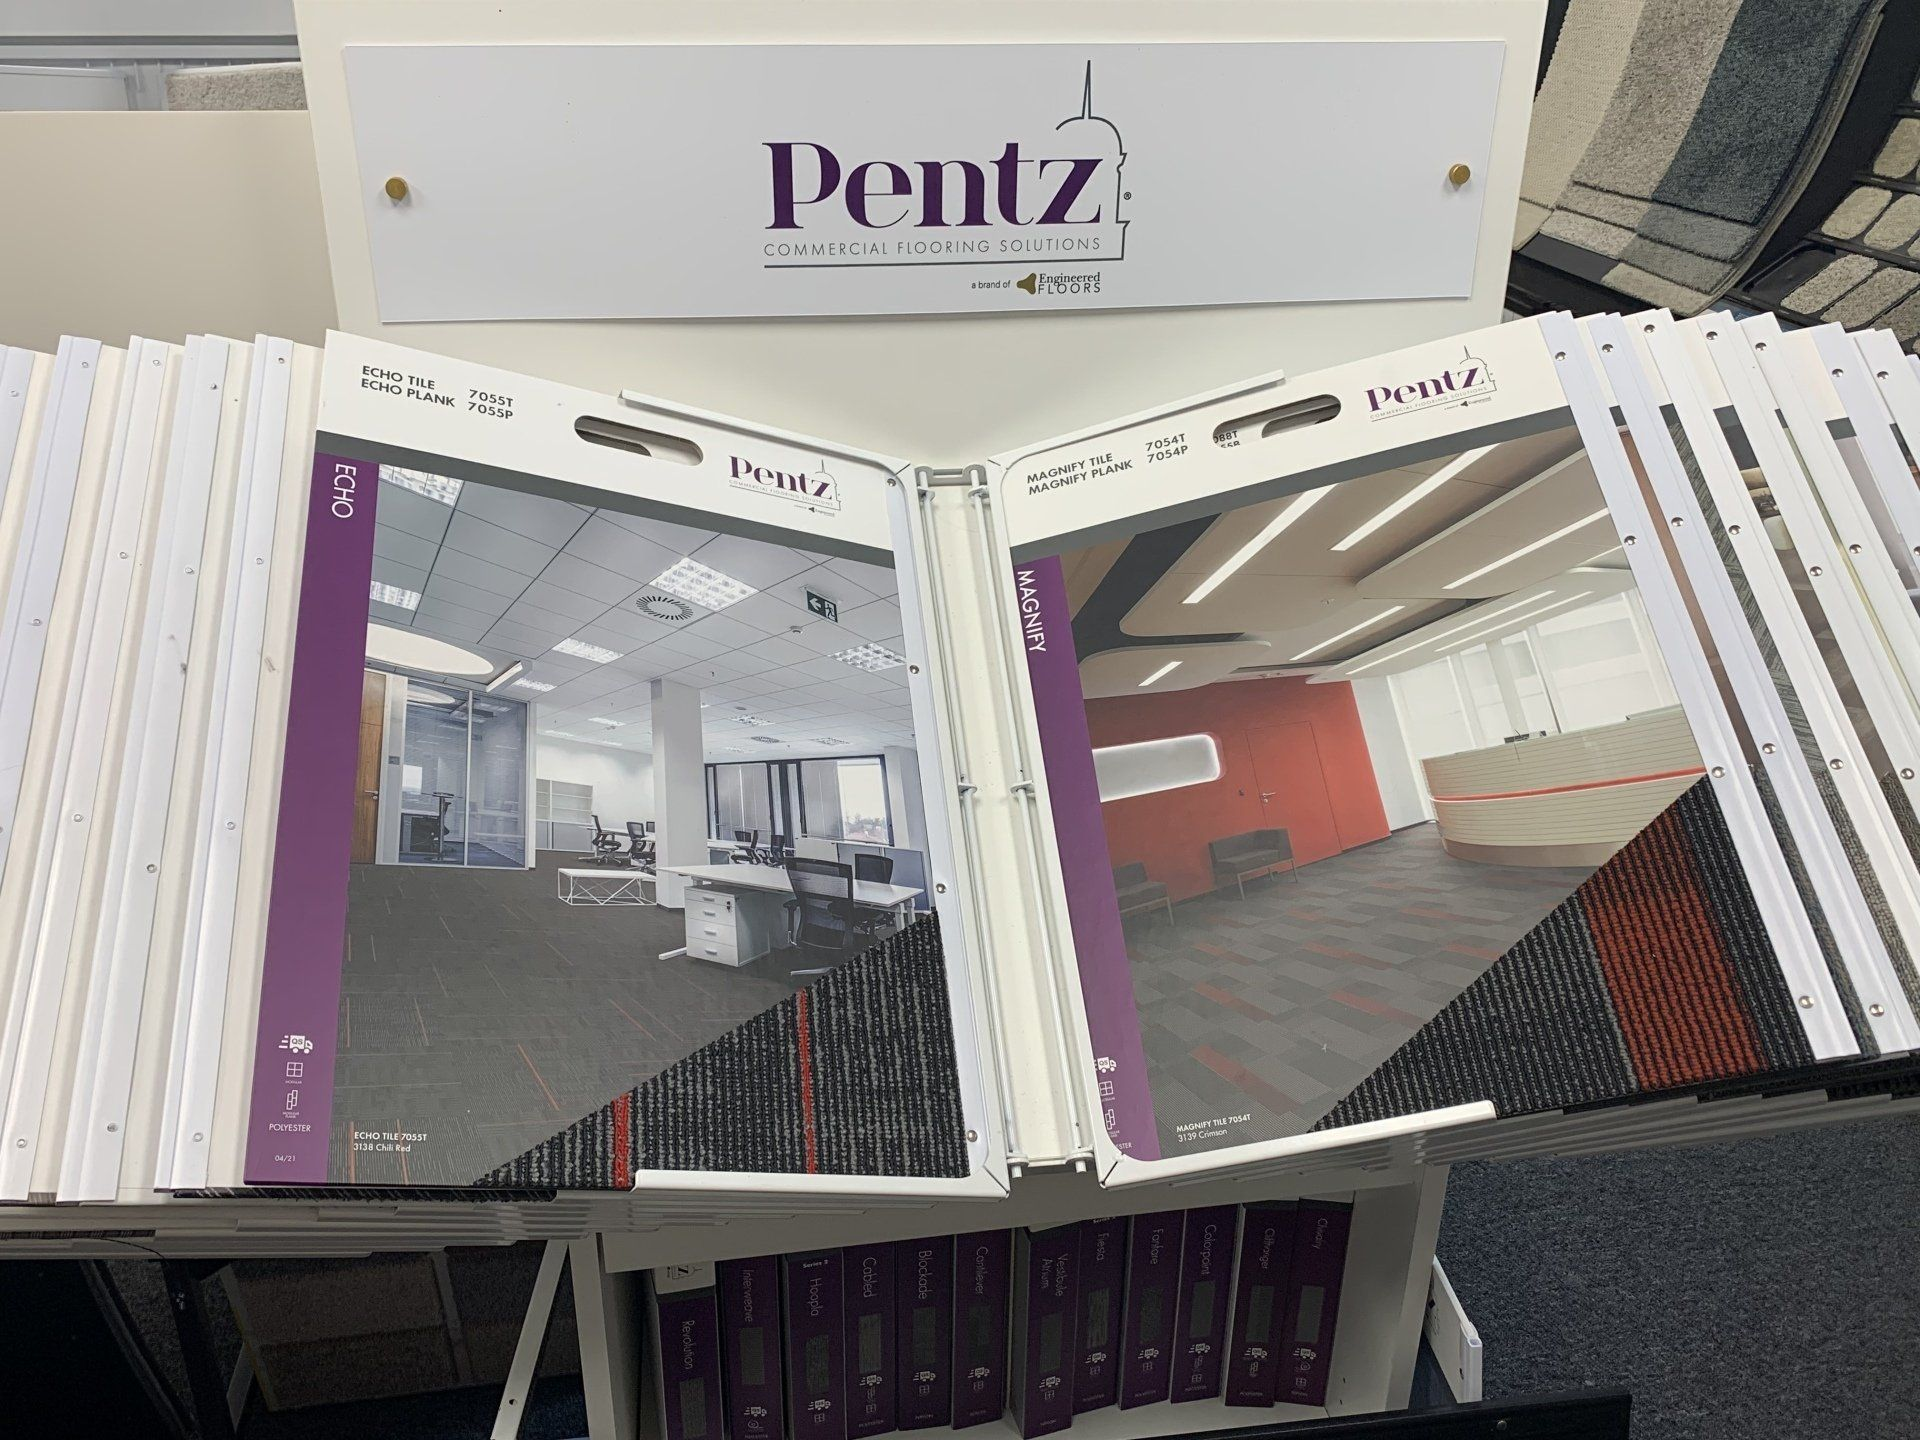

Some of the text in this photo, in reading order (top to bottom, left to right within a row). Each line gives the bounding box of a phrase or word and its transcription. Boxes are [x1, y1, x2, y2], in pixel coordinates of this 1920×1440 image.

[761, 142, 1104, 229] Pentz
[764, 237, 1100, 257] COMMERCIAL FLOORING SOLUTIONS
[978, 280, 1001, 289] brand
[1003, 280, 1011, 288] of
[1038, 282, 1101, 294] FLOORS
[1039, 271, 1101, 287] Engineered
[361, 378, 514, 420] ECHO PLANK 7055P
[362, 365, 514, 408] ECHO TILE 7055T
[1364, 367, 1485, 412] Pentz
[1145, 433, 1186, 452] 7054T
[1147, 444, 1189, 464] 7054P
[728, 455, 832, 499] Pentz
[1026, 452, 1113, 484] MAGNIFY TILE
[1028, 459, 1133, 495] MAGNIFY PLANK
[332, 463, 356, 519] ECHO
[1017, 569, 1046, 653] MAGNIFY
[268, 1122, 312, 1133] POLYESTER
[354, 1131, 428, 1142] ECHO TILE 7055T
[1176, 1113, 1251, 1133] MAGNIFY TILE 7054T
[1177, 1128, 1228, 1143] 3139 Crimson
[274, 1154, 296, 1162] 04/21
[353, 1142, 411, 1152] 3138 Chili Red
[1201, 1224, 1217, 1276] Colorpoint
[863, 1257, 877, 1299] Cabled
[918, 1249, 933, 1300] Blockade
[810, 1277, 822, 1317] Hoopla
[681, 1319, 696, 1371] Revolution
